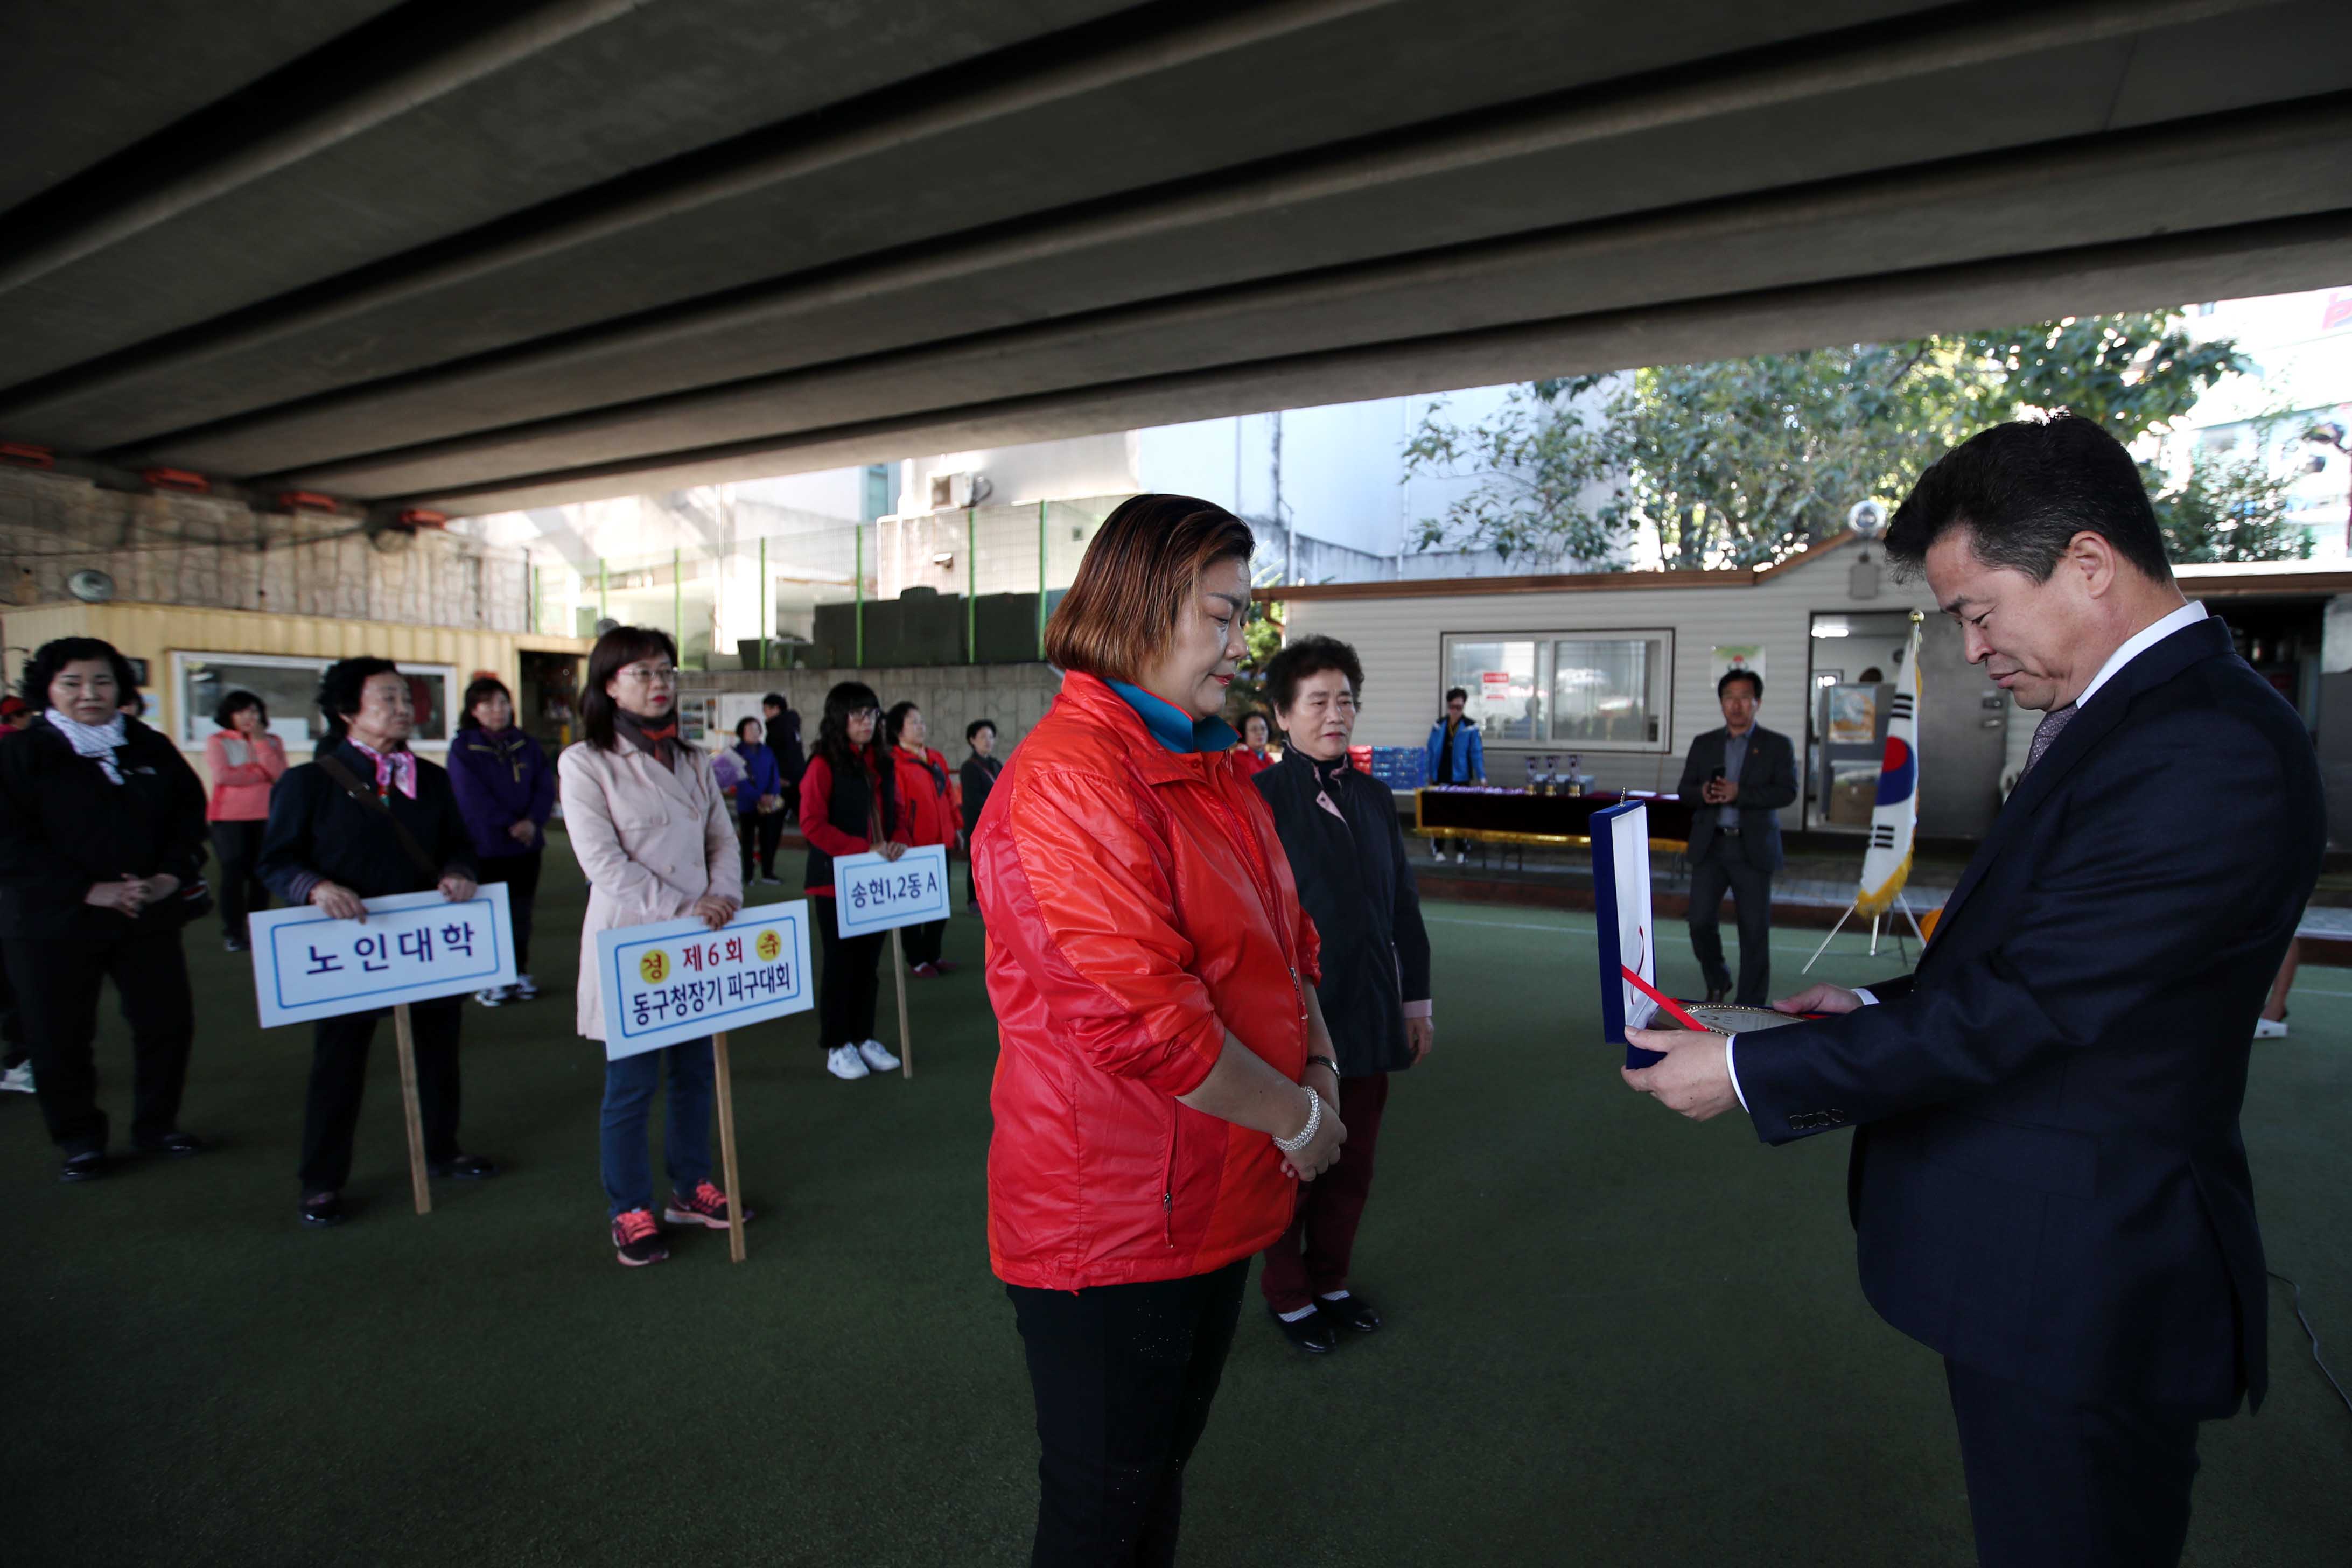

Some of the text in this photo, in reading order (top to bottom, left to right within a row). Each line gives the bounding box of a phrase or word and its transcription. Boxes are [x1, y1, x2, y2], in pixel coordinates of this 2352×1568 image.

[851, 871, 937, 908] 송현1,2동 A
[306, 922, 474, 975] 노인대학
[642, 953, 663, 980] 경
[759, 933, 778, 956] 축
[633, 962, 790, 1026] 동구청장기 피구대회
